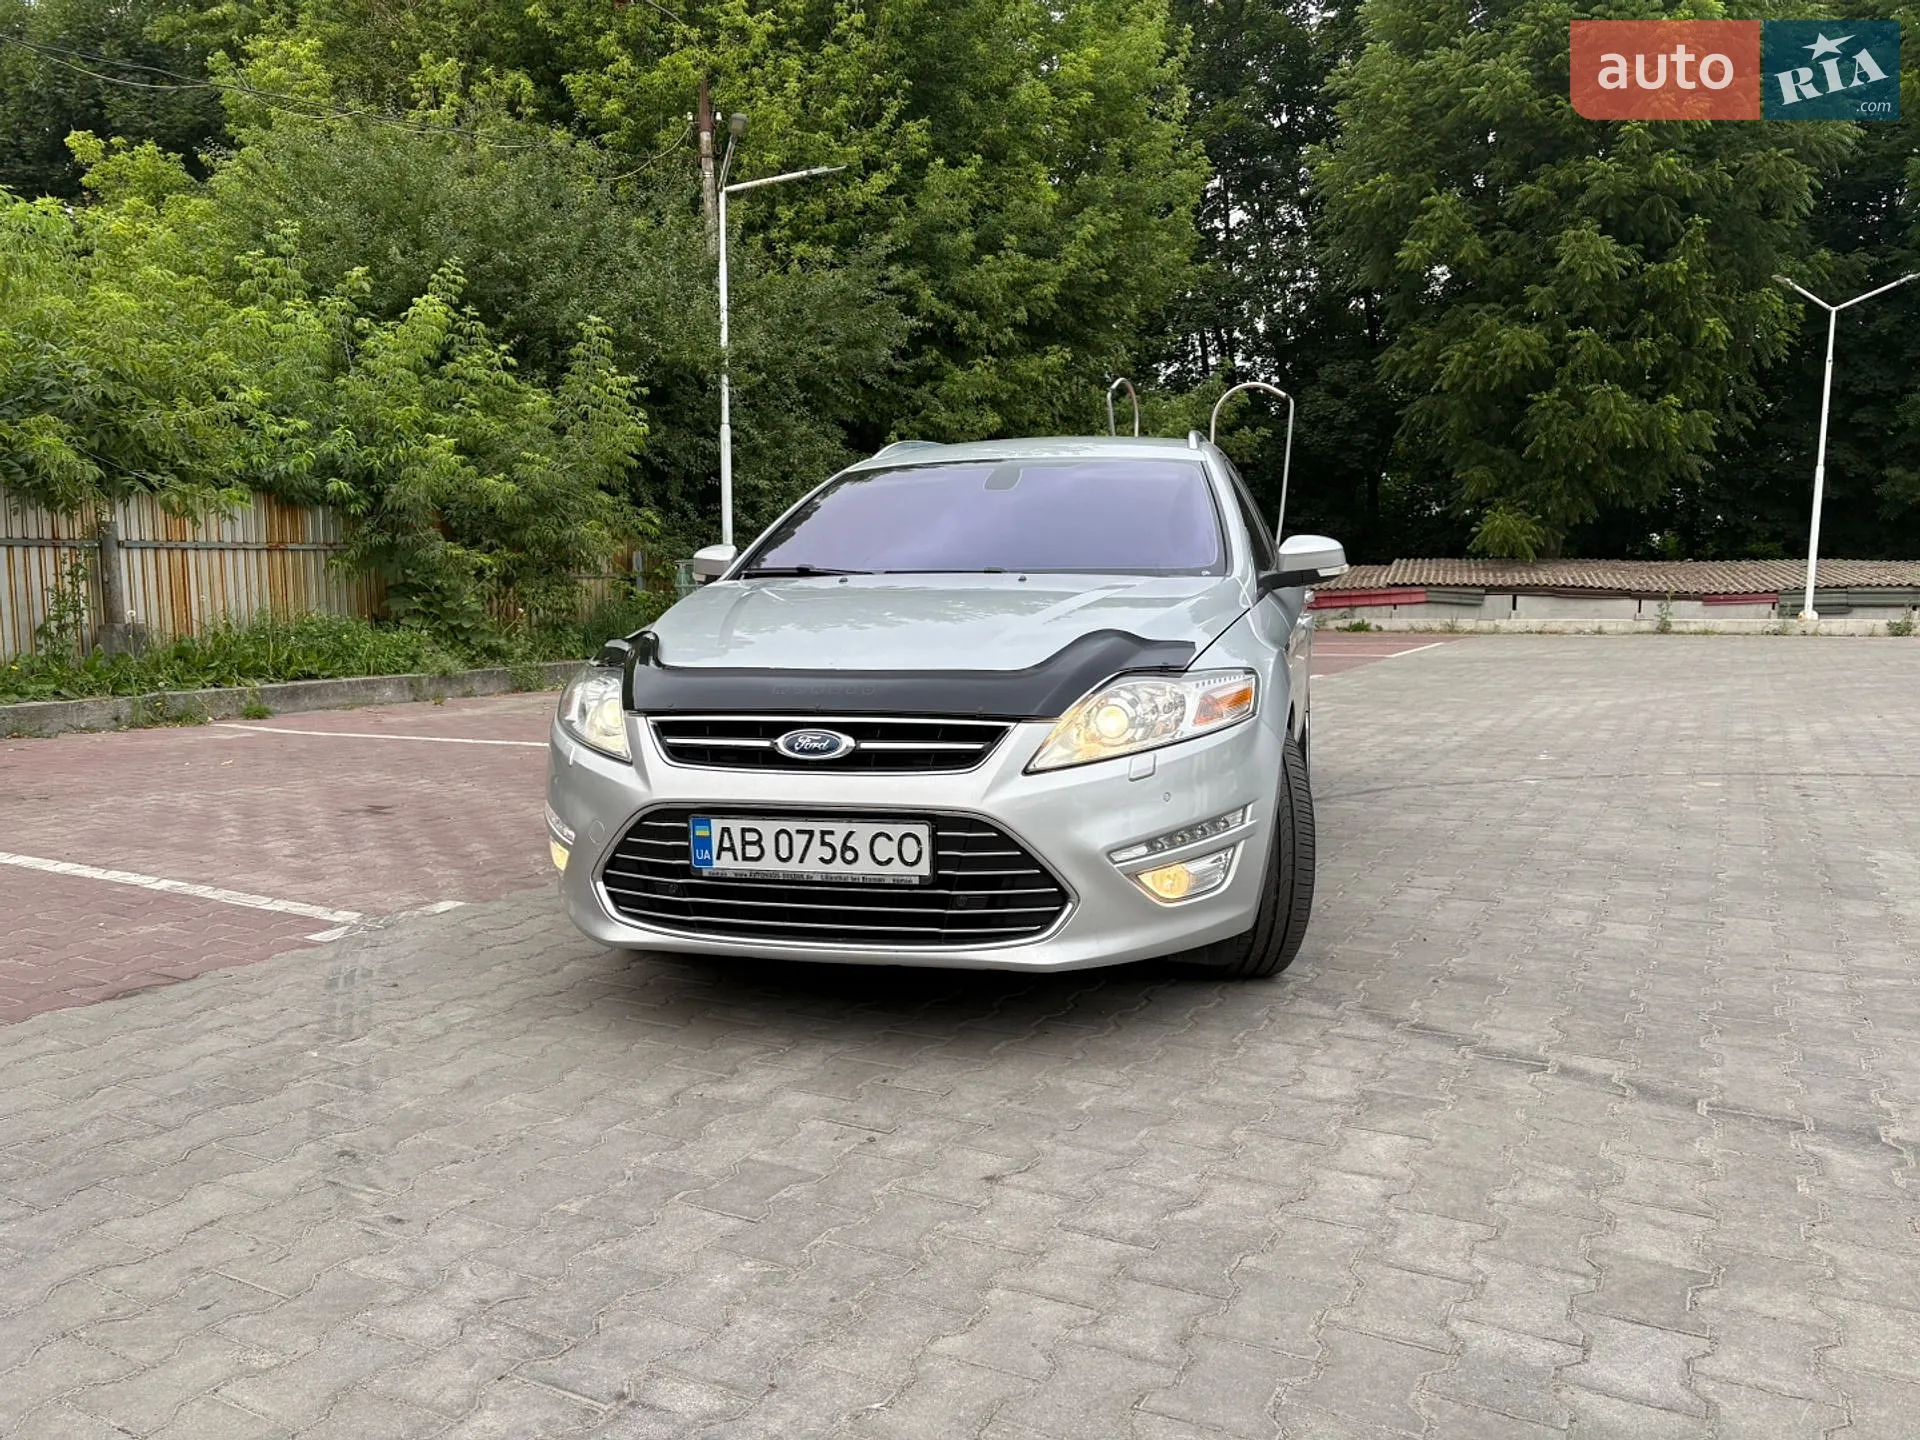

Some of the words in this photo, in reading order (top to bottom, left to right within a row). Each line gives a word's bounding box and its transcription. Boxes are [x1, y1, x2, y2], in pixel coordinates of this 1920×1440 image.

[794, 735, 831, 751] Ford
[715, 826, 765, 863] AB
[774, 828, 860, 866] 0756
[869, 831, 924, 868] CO
[695, 850, 711, 861] UA
